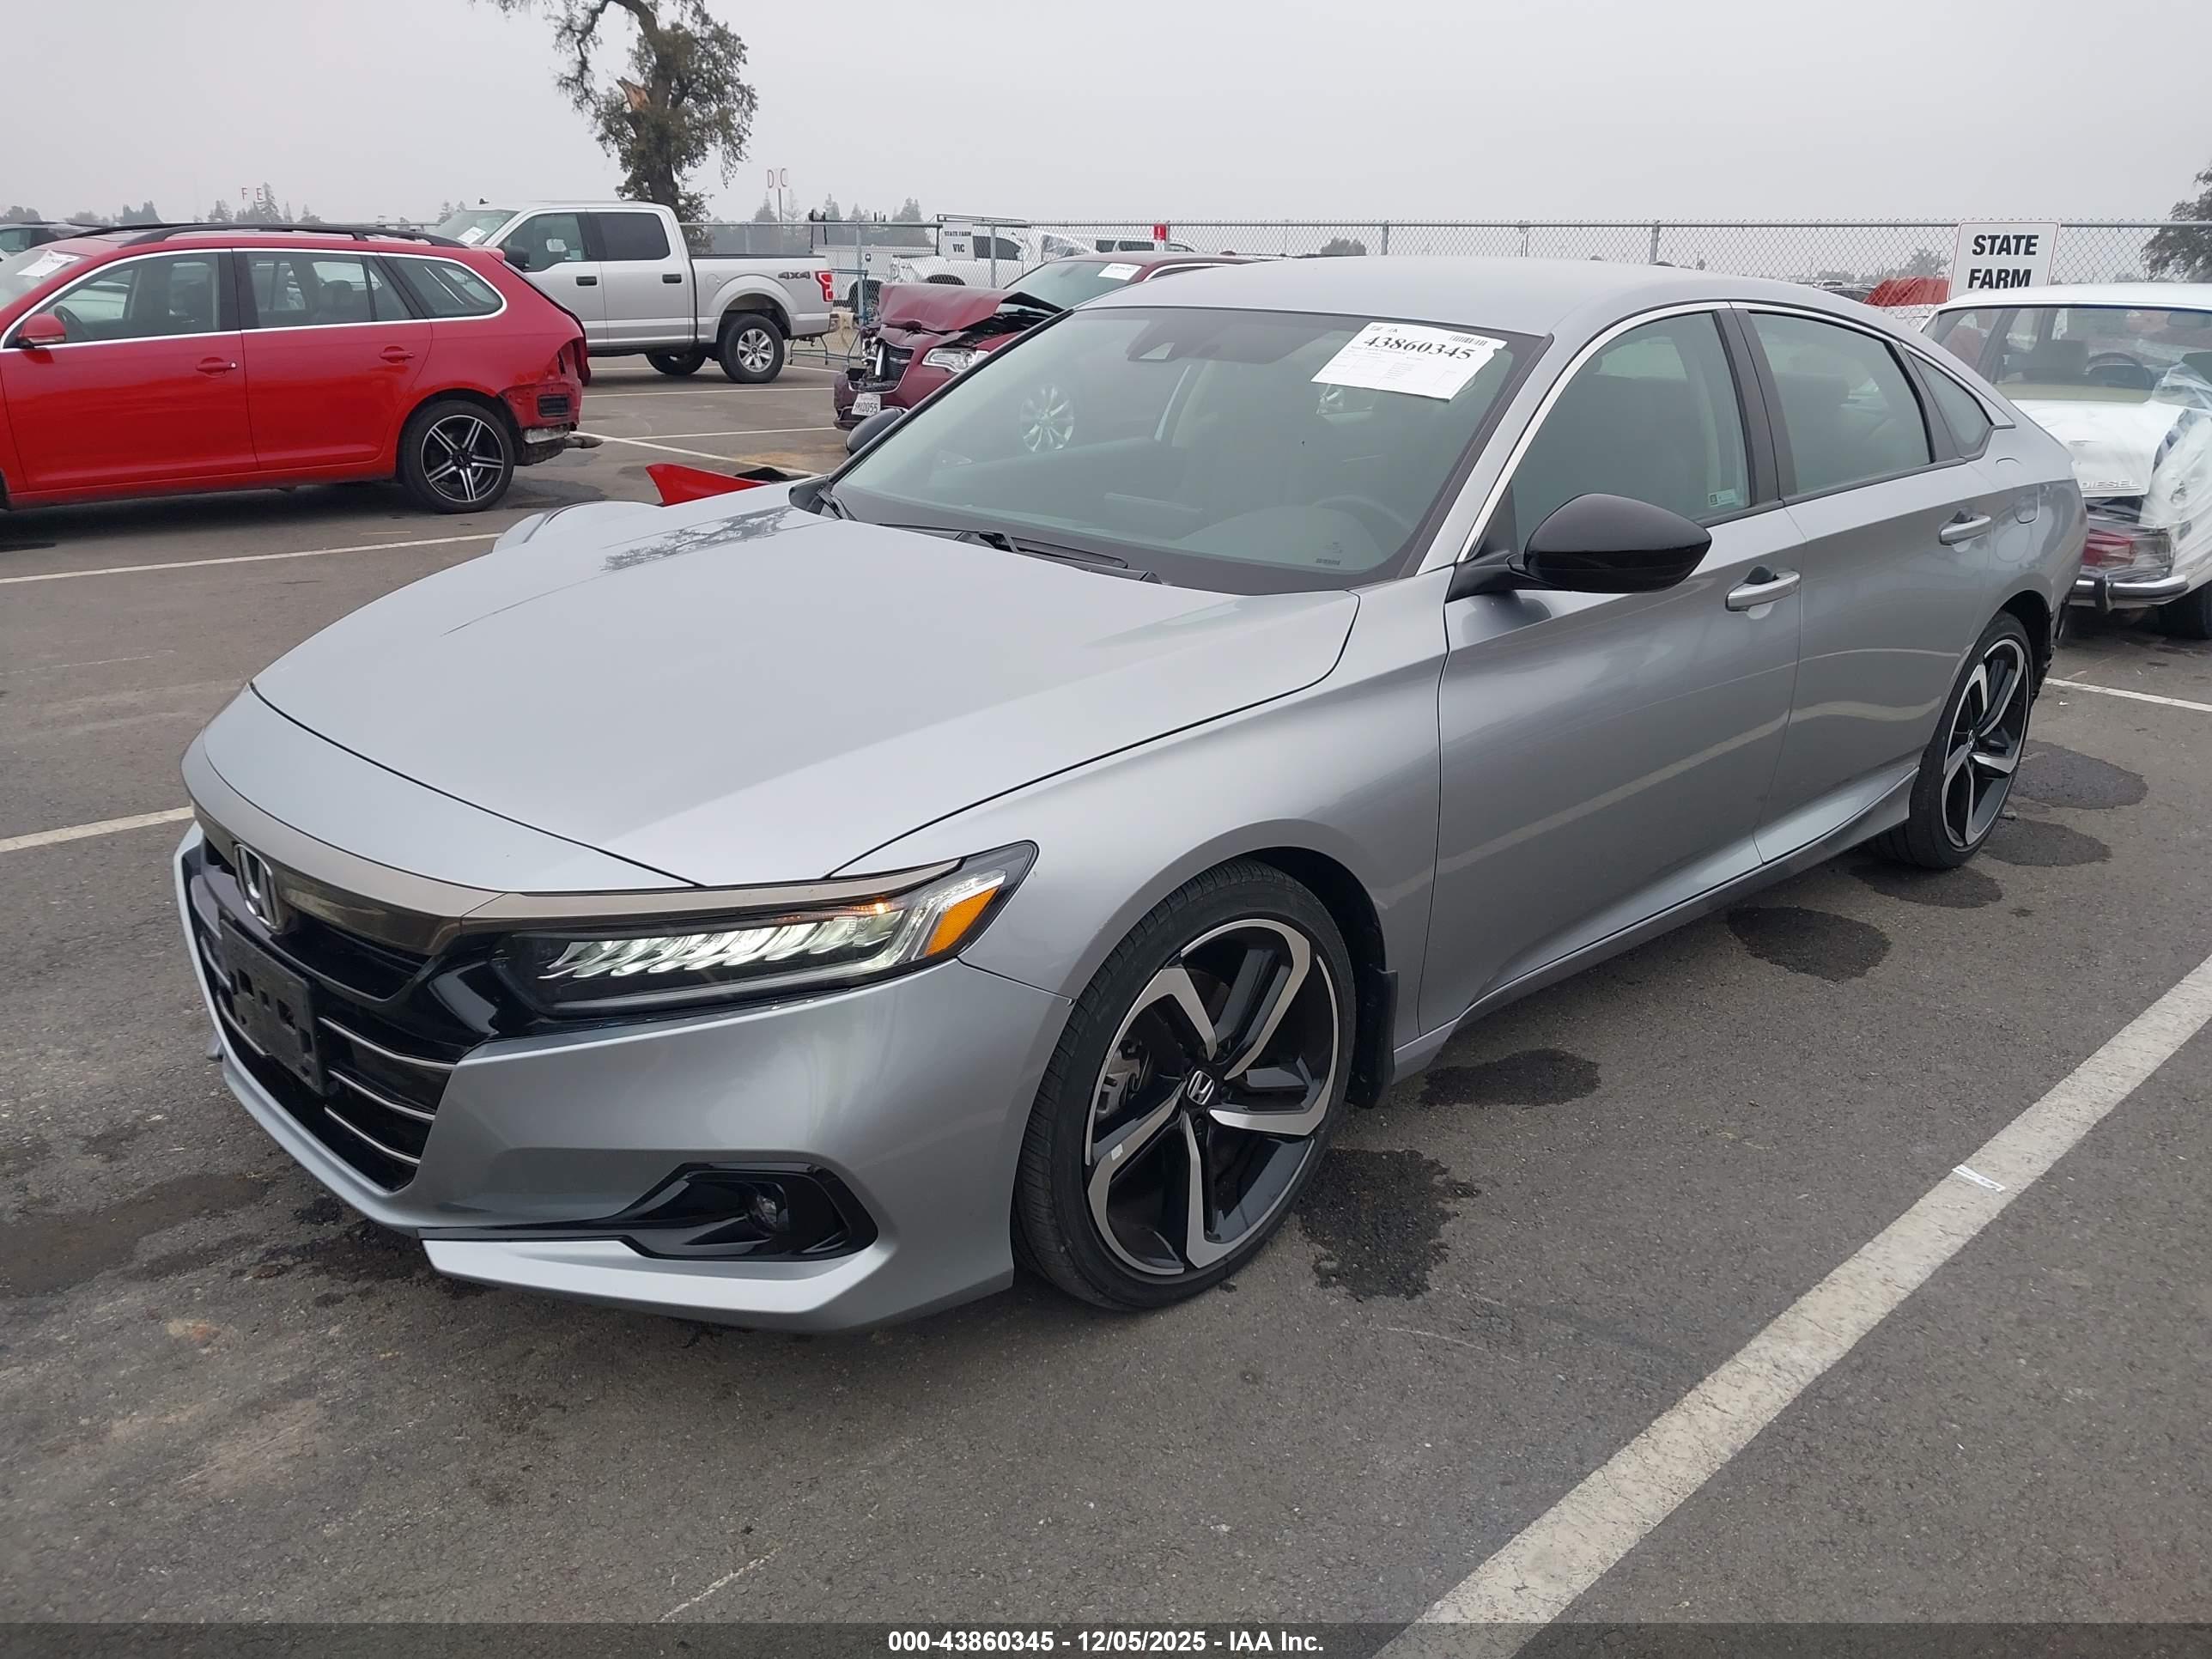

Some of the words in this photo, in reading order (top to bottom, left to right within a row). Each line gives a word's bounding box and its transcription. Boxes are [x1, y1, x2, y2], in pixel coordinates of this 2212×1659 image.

[780, 167, 787, 187] C
[240, 187, 248, 200] F
[256, 187, 264, 201] E
[952, 243, 965, 252] VIC
[1972, 234, 2039, 256] STATE
[1967, 268, 2032, 289] FARM
[1364, 336, 1476, 360] 43860345
[2081, 479, 2139, 489] DIESEL
